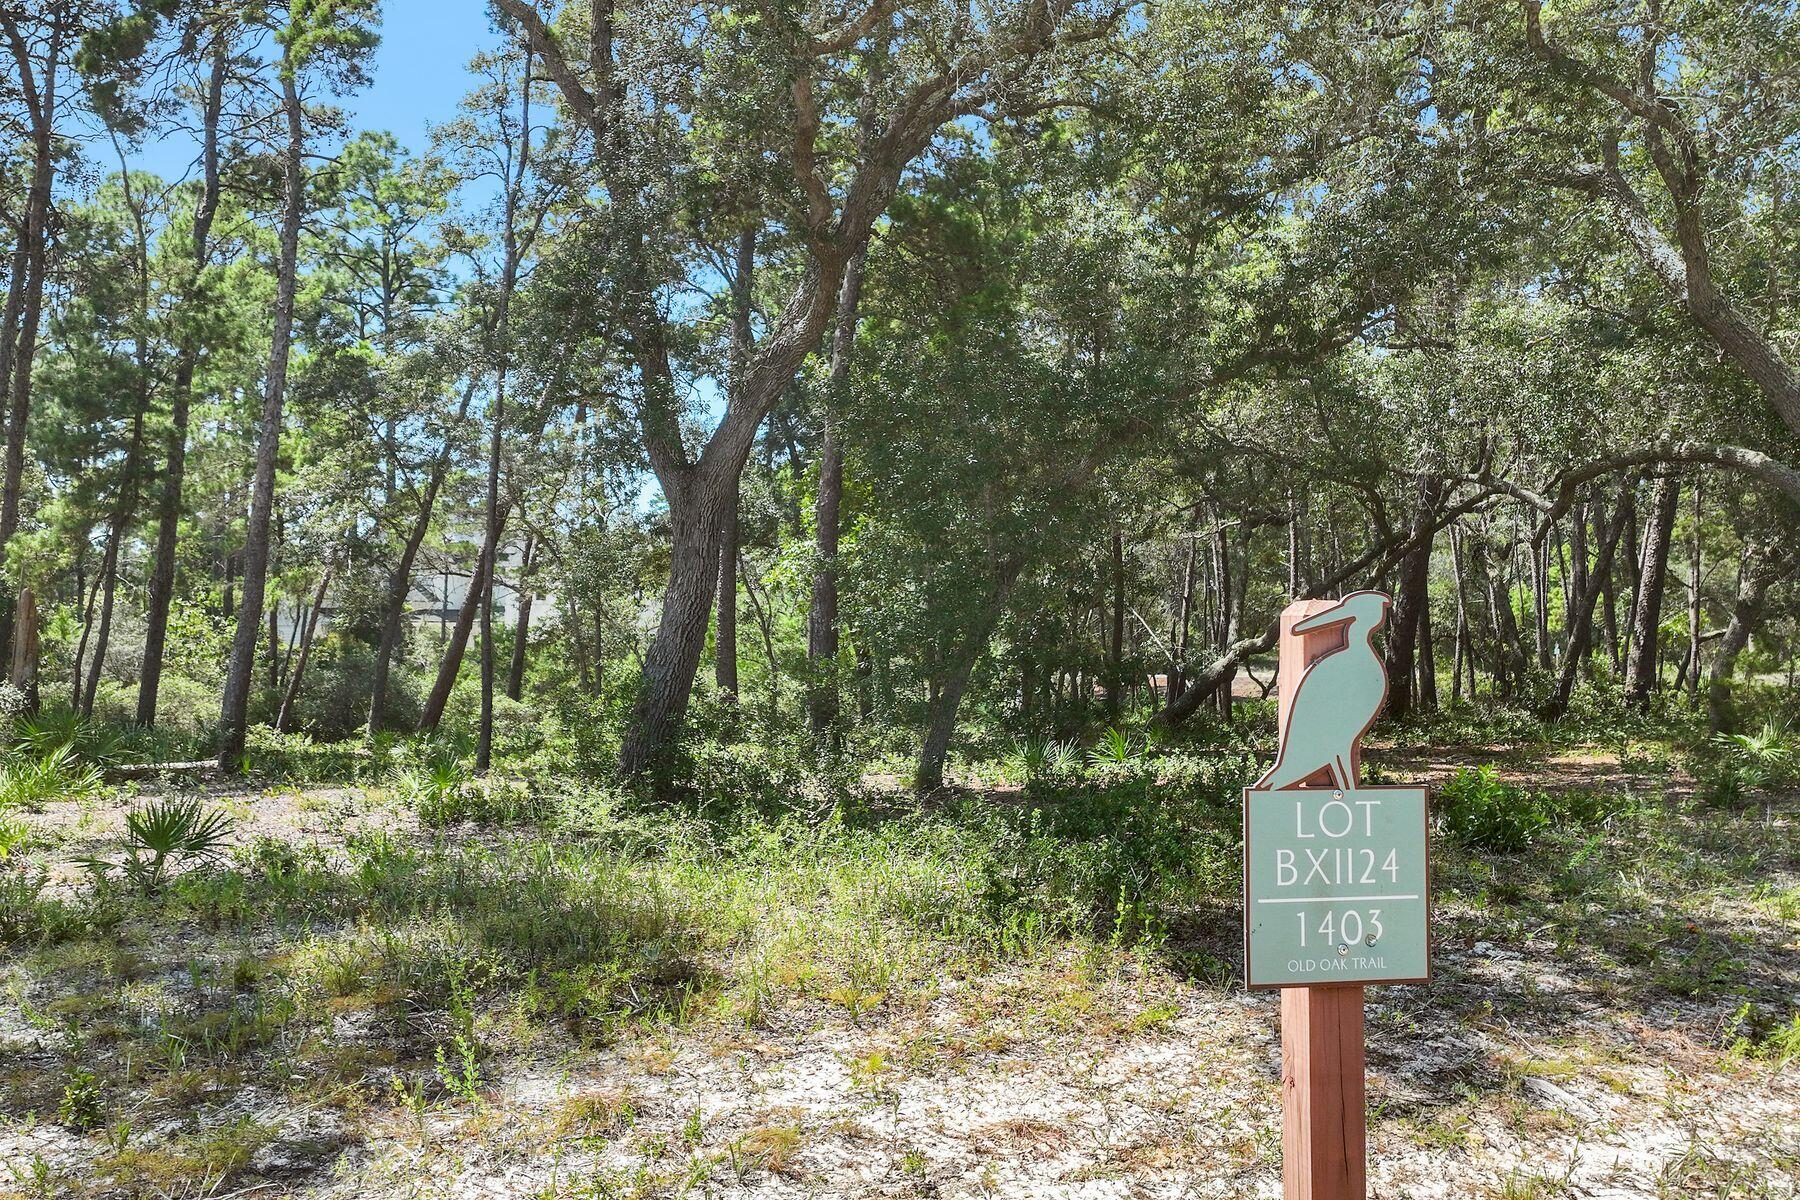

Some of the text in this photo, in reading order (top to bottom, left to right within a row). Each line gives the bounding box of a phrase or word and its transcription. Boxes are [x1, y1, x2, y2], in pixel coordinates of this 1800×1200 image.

[1296, 801, 1381, 838] LOT
[1296, 909, 1383, 947] 1403
[1287, 956, 1387, 973] OLD OAK TRAIL
